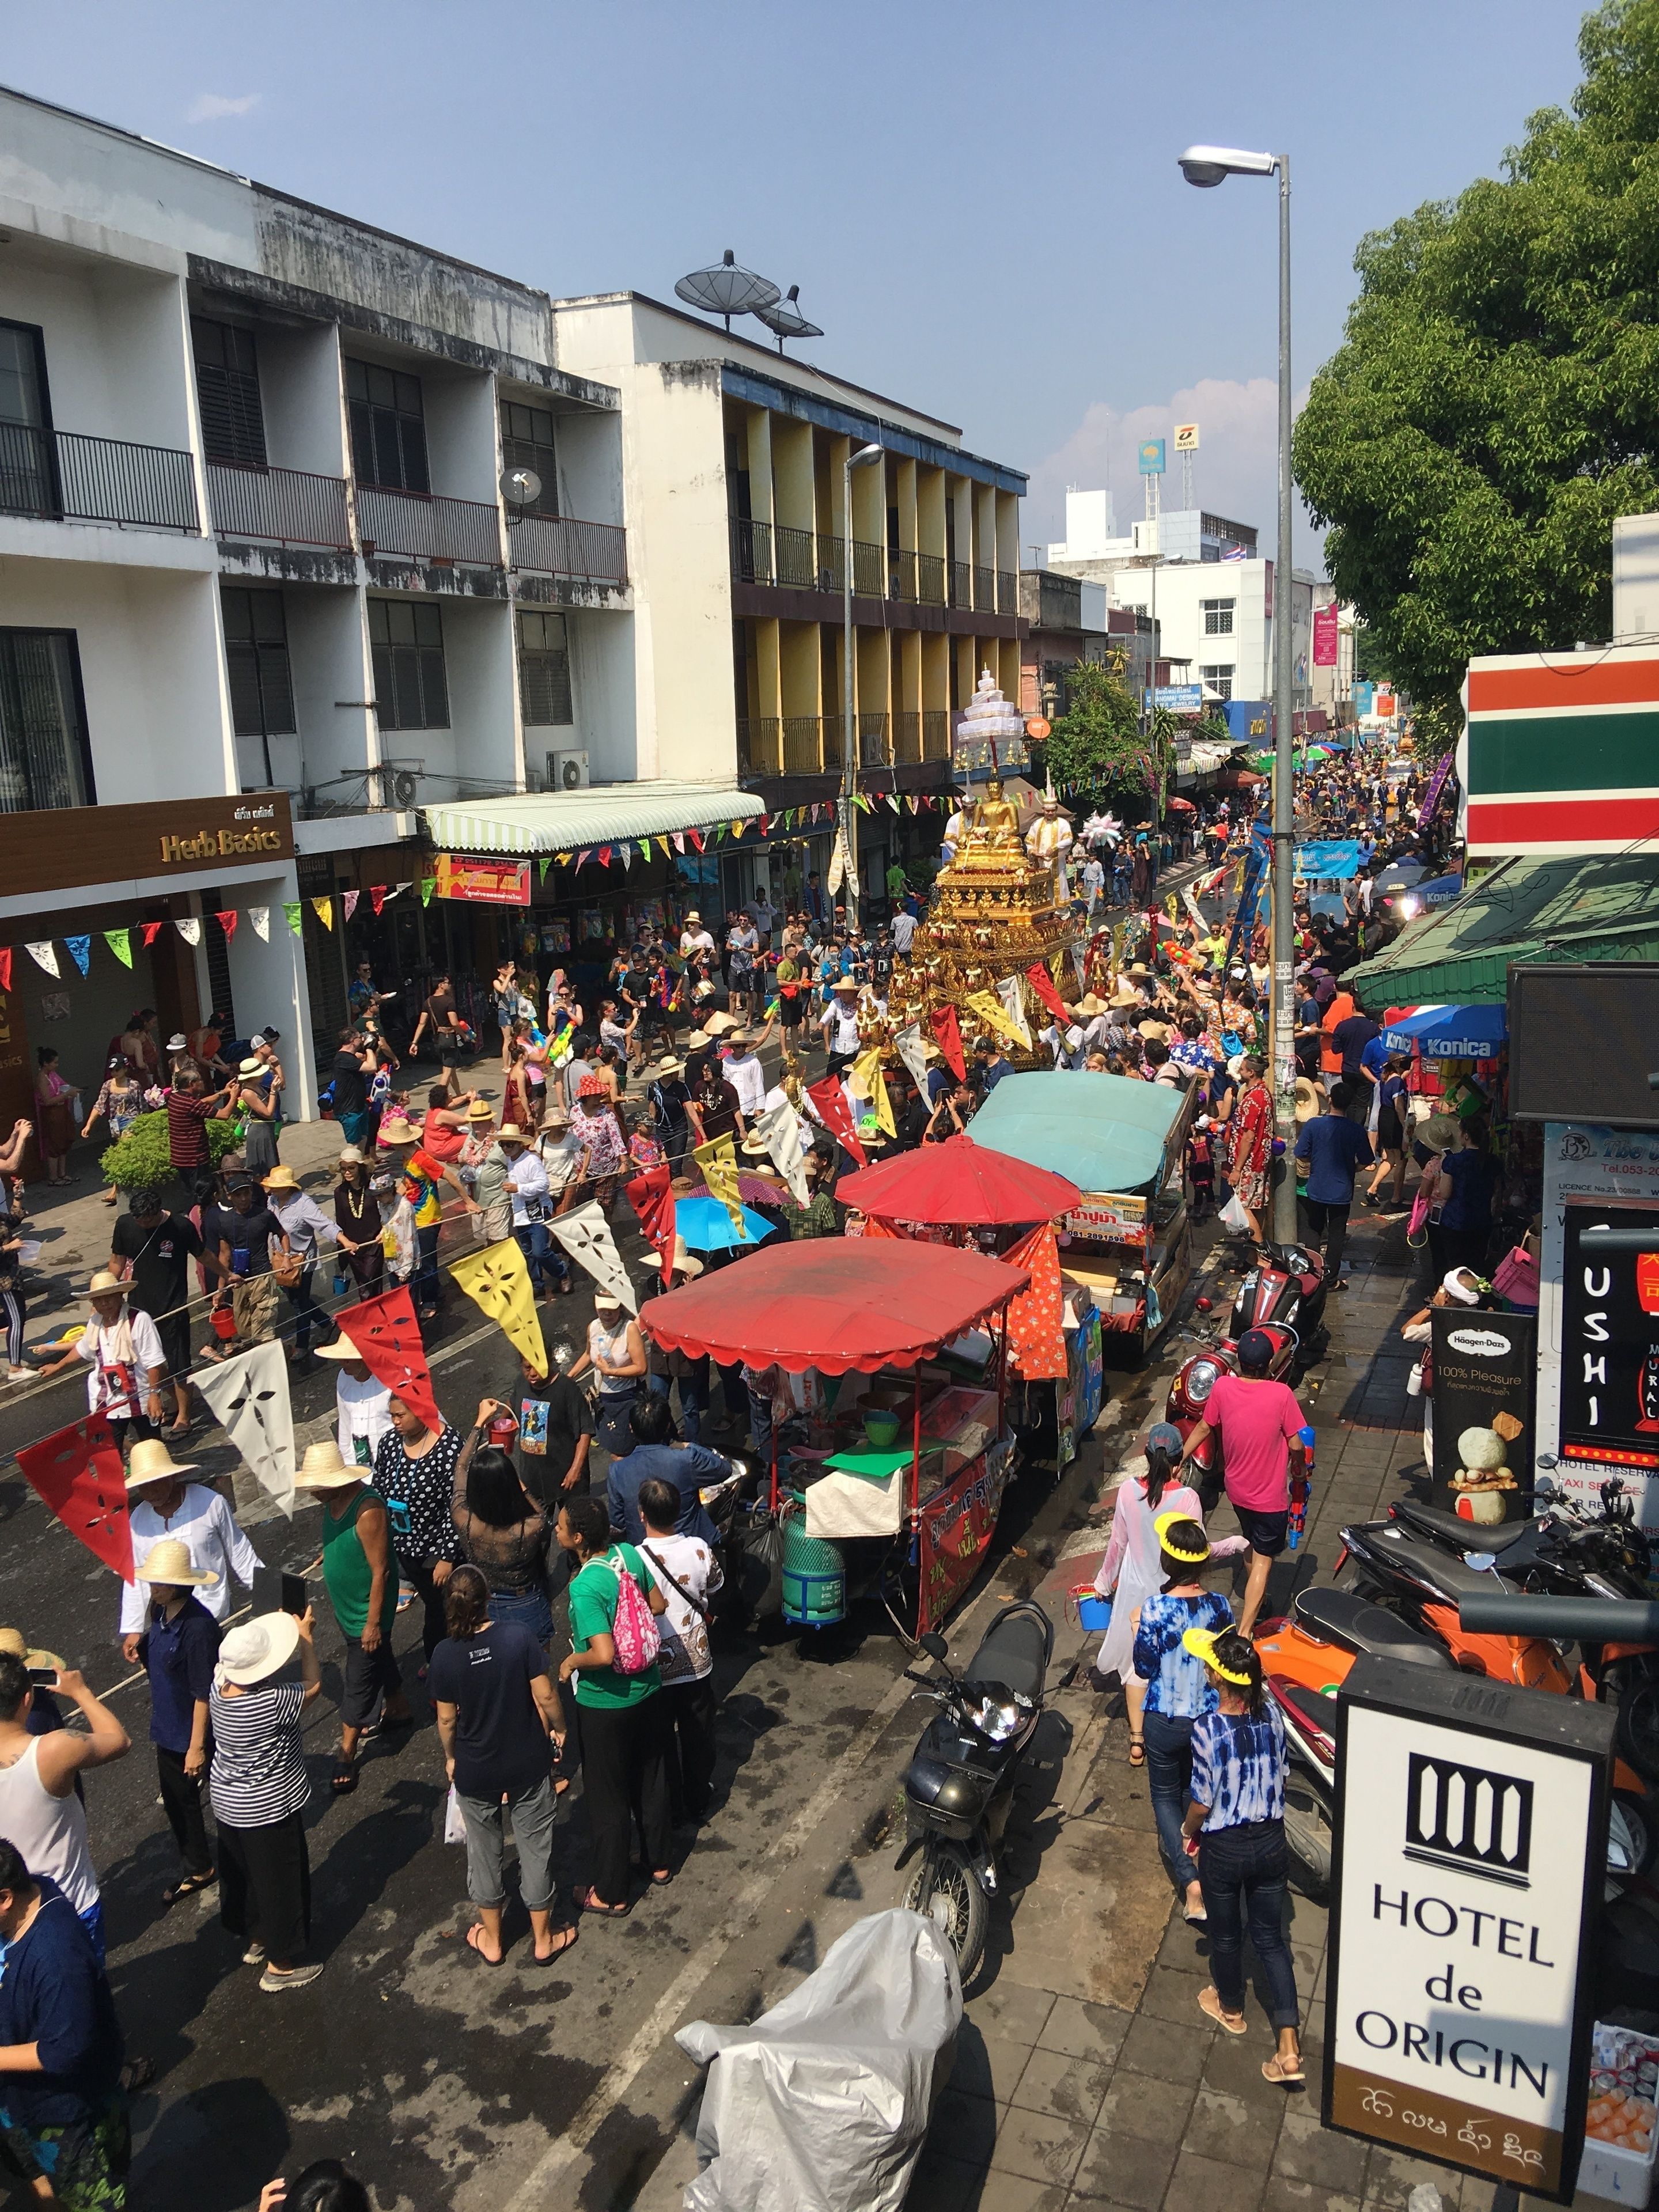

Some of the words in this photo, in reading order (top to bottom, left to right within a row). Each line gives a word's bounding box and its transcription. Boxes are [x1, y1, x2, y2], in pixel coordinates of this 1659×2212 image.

[160, 830, 217, 862] Herb
[217, 826, 281, 855] Basics
[1386, 1032, 1412, 1053] Konica
[1427, 1037, 1491, 1057] Konica
[1559, 1183, 1592, 1191] LICENCE
[1454, 1335, 1505, 1349] Häagen-Dazs
[1438, 1366, 1468, 1378] 100%
[1471, 1369, 1522, 1385] Pleasure
[1559, 1460, 1600, 1472] HOTEL
[959, 1737, 978, 1747] HONDA
[1373, 1883, 1554, 1968] HOTEL
[1425, 1964, 1483, 2011] de
[1355, 2010, 1548, 2099] ORIGIN
